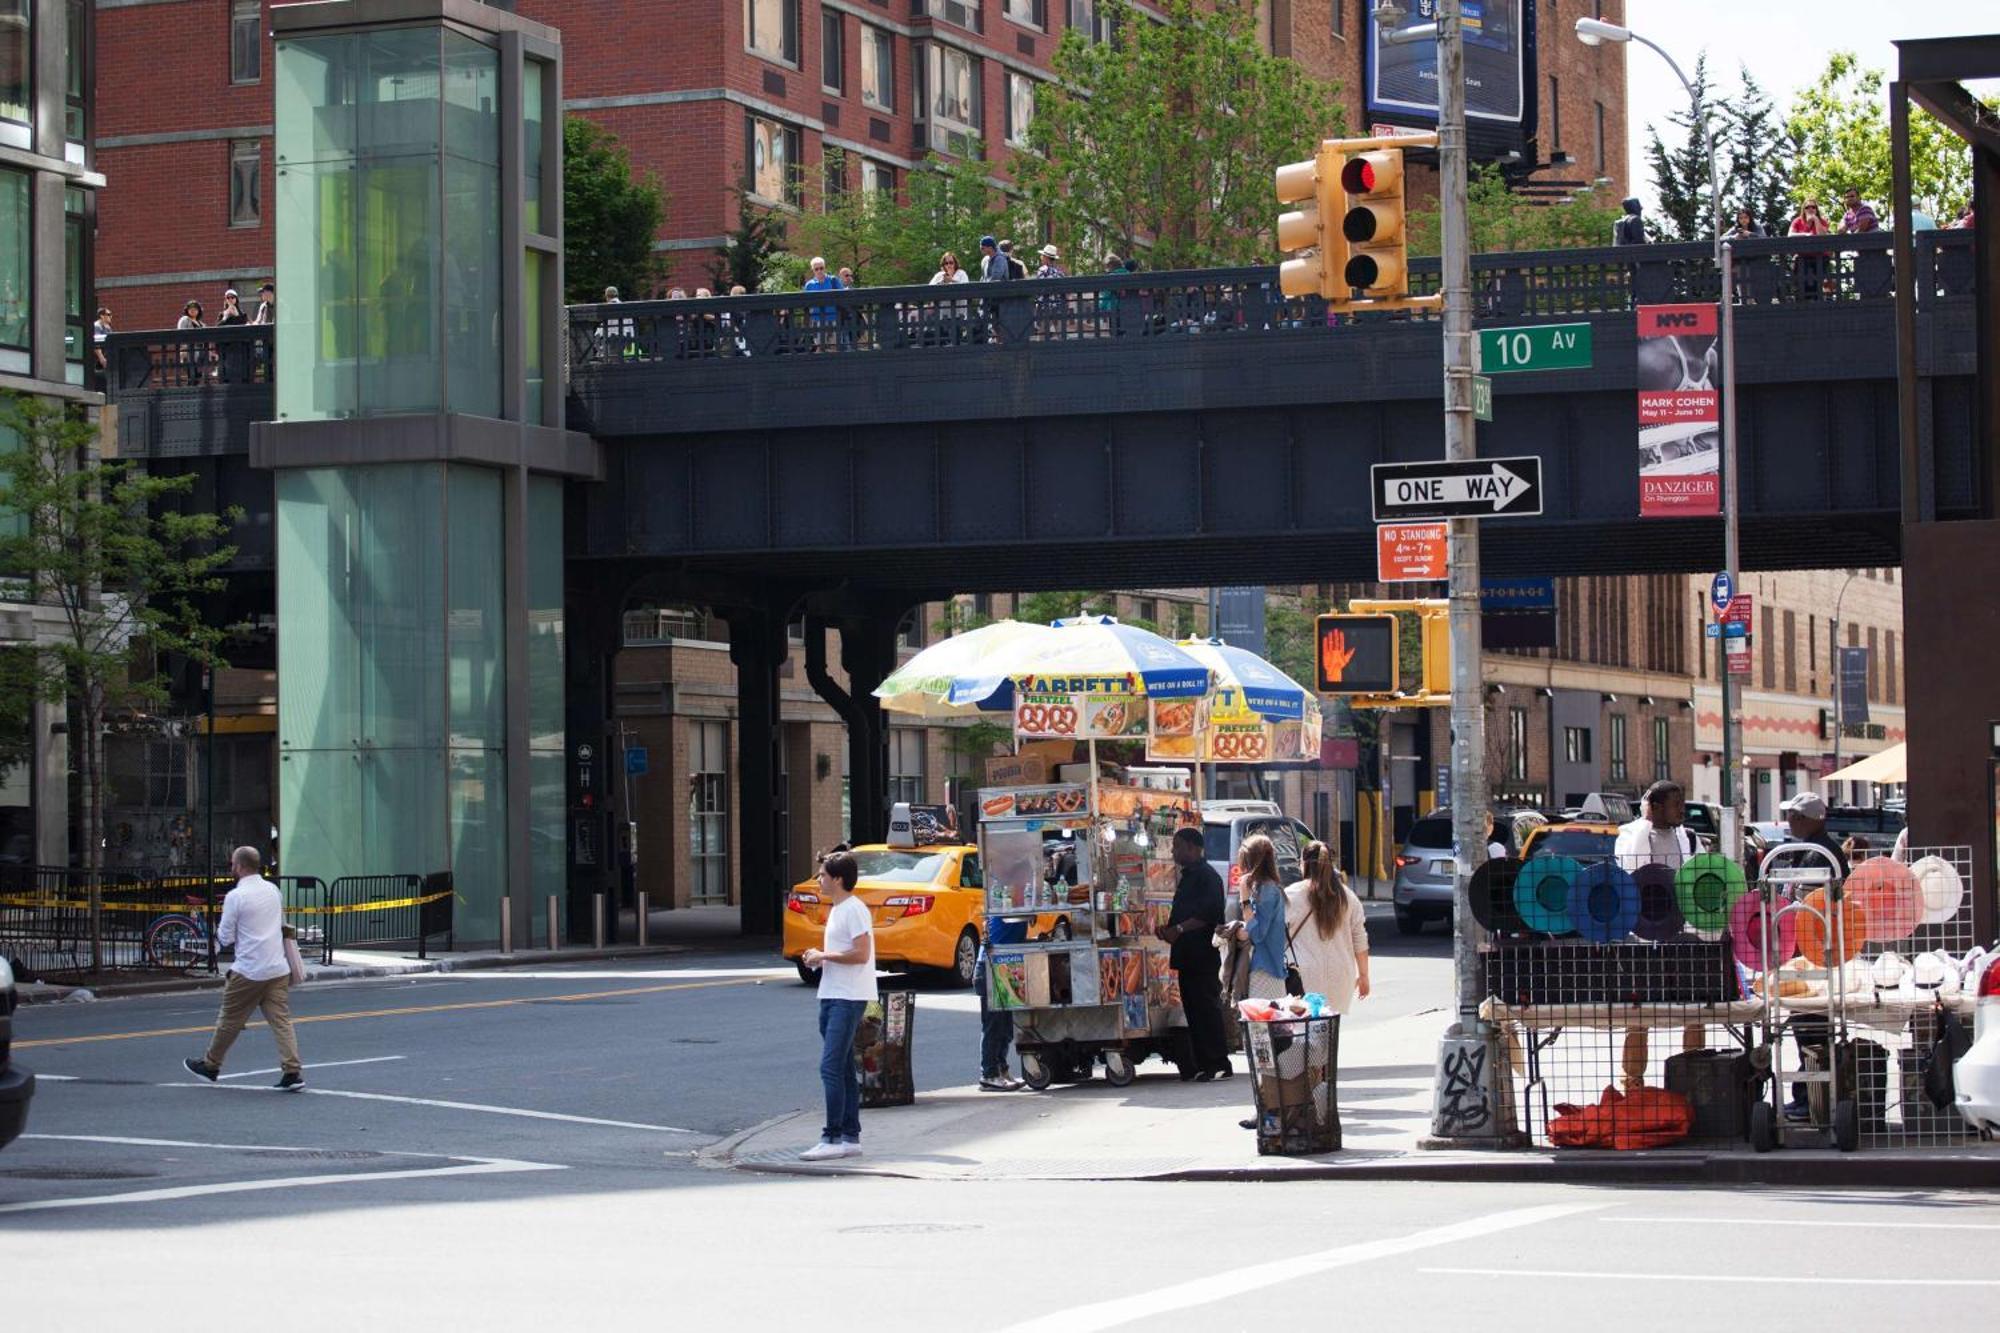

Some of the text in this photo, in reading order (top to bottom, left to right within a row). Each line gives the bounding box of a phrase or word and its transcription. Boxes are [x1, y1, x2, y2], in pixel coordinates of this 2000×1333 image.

[1656, 313, 1697, 327] NYC
[1497, 330, 1575, 365] 10 Av
[1642, 397, 1714, 407] MARK COHEN
[1642, 409, 1657, 417] May
[1695, 408, 1704, 416] 10
[1397, 476, 1514, 502] ONE WAY
[1644, 481, 1714, 493] DANZIGER
[1384, 528, 1442, 542] NO STANDING
